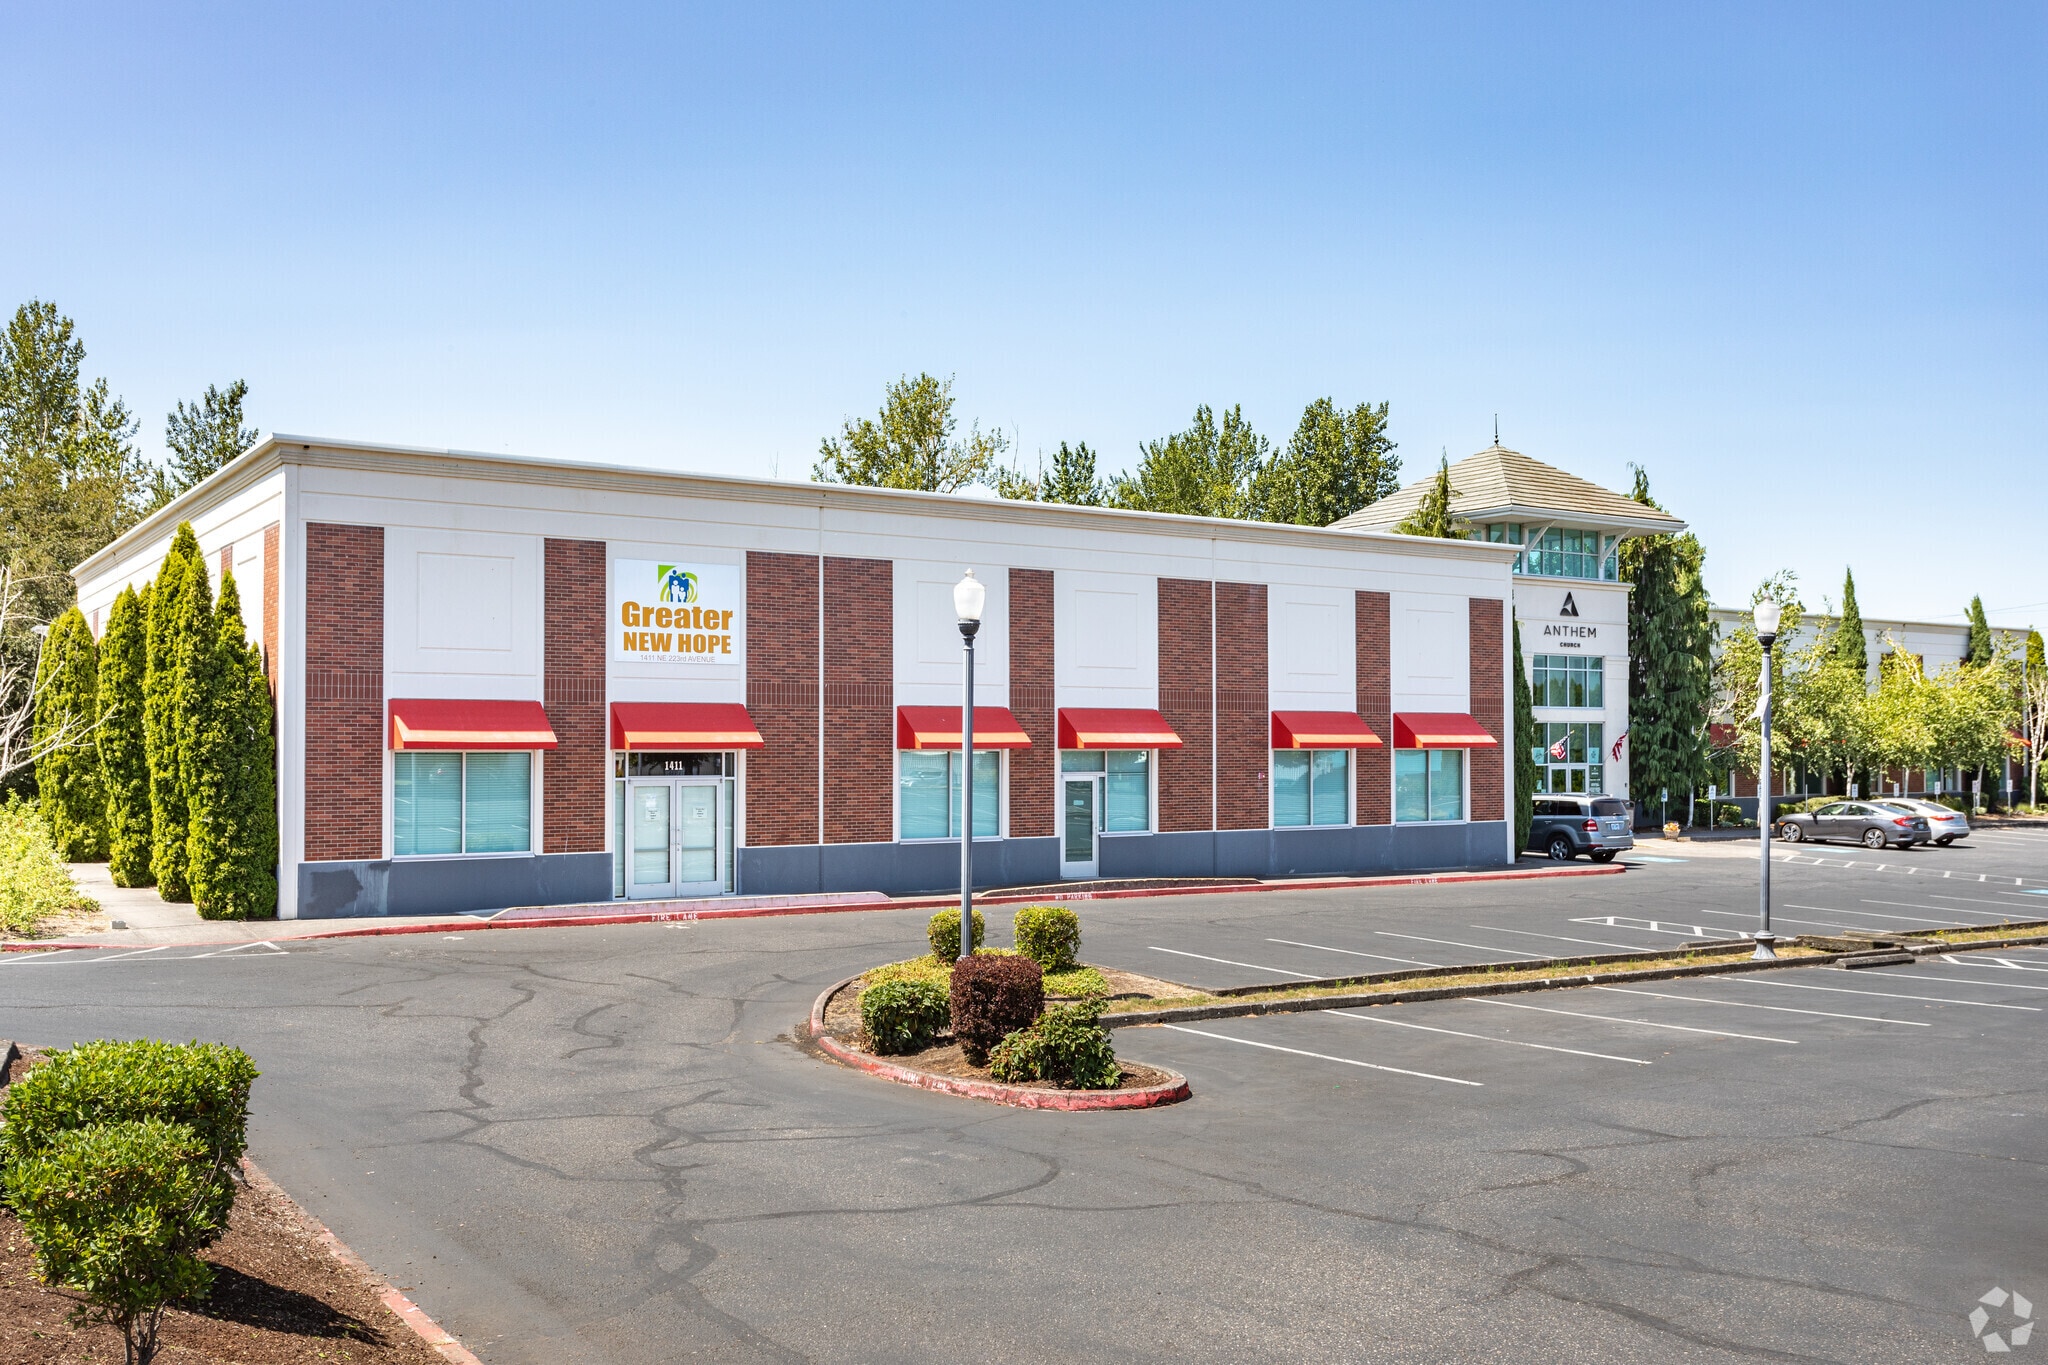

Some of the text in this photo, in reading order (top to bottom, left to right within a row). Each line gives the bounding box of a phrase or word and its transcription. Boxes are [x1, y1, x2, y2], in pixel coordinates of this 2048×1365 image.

[621, 601, 734, 631] Greater
[1543, 624, 1597, 638] ANTHEM
[623, 631, 732, 654] NEW HOPE
[657, 654, 667, 662] NE
[688, 655, 716, 663] AVENUE
[664, 760, 683, 770] 1411
[651, 912, 698, 922] FIRE LANE
